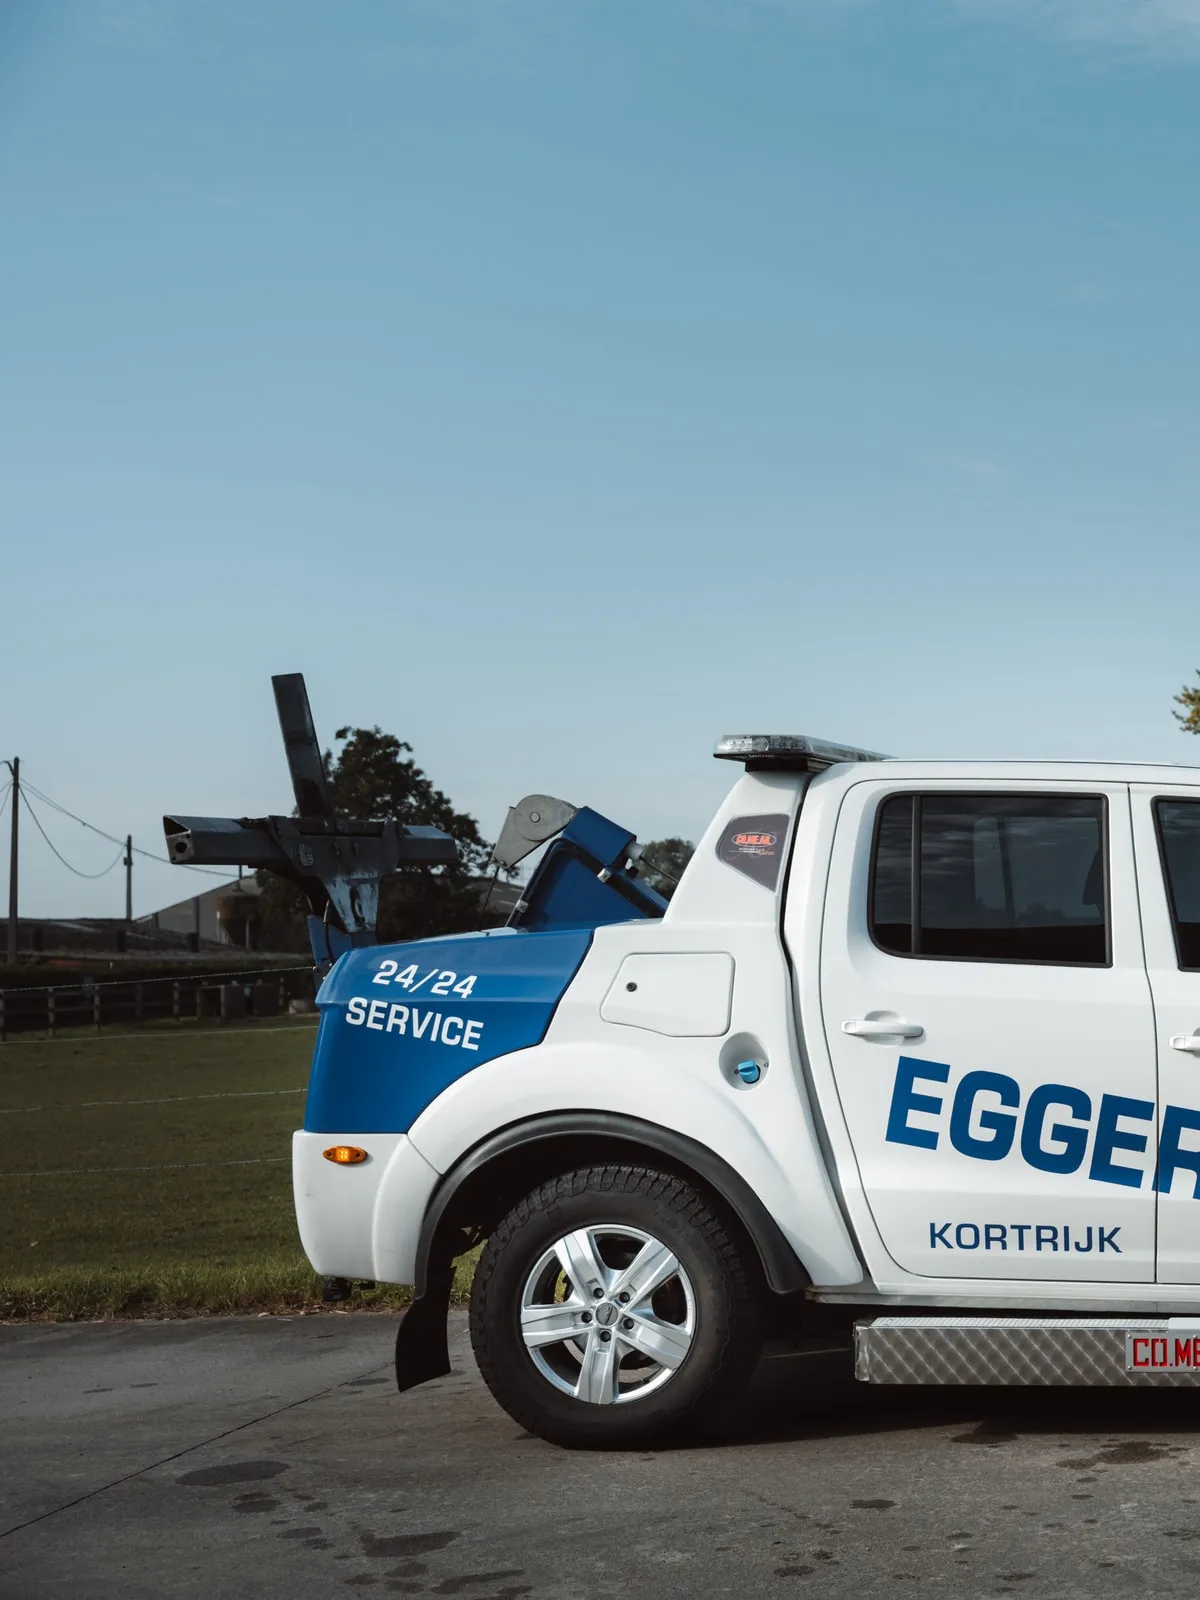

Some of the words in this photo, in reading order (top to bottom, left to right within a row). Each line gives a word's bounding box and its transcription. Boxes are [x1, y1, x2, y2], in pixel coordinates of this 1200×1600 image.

[372, 959, 478, 999] 24/24
[345, 996, 484, 1051] SERVICE
[929, 1222, 1123, 1254] KORTRIJK
